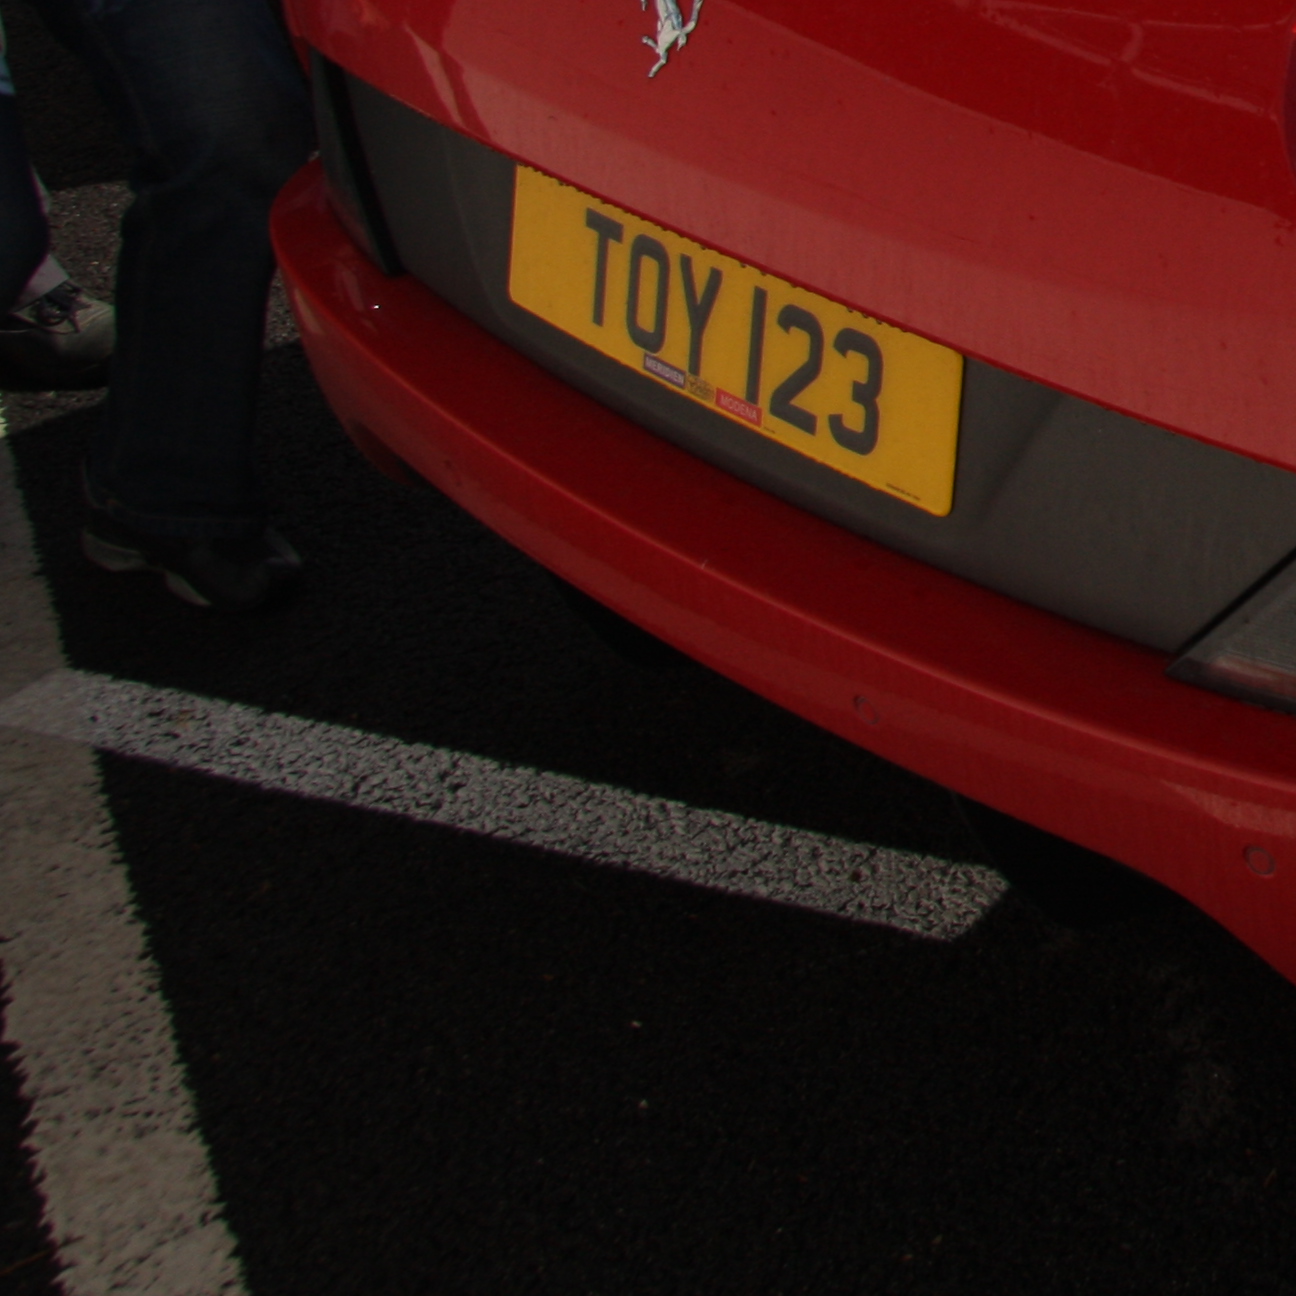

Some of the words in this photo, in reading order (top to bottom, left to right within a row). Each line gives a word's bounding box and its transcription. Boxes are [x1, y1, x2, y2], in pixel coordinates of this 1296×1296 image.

[585, 207, 723, 376] TOY
[745, 285, 884, 456] 123
[645, 355, 685, 387] MERIDIEN
[720, 394, 758, 422] MODENA
